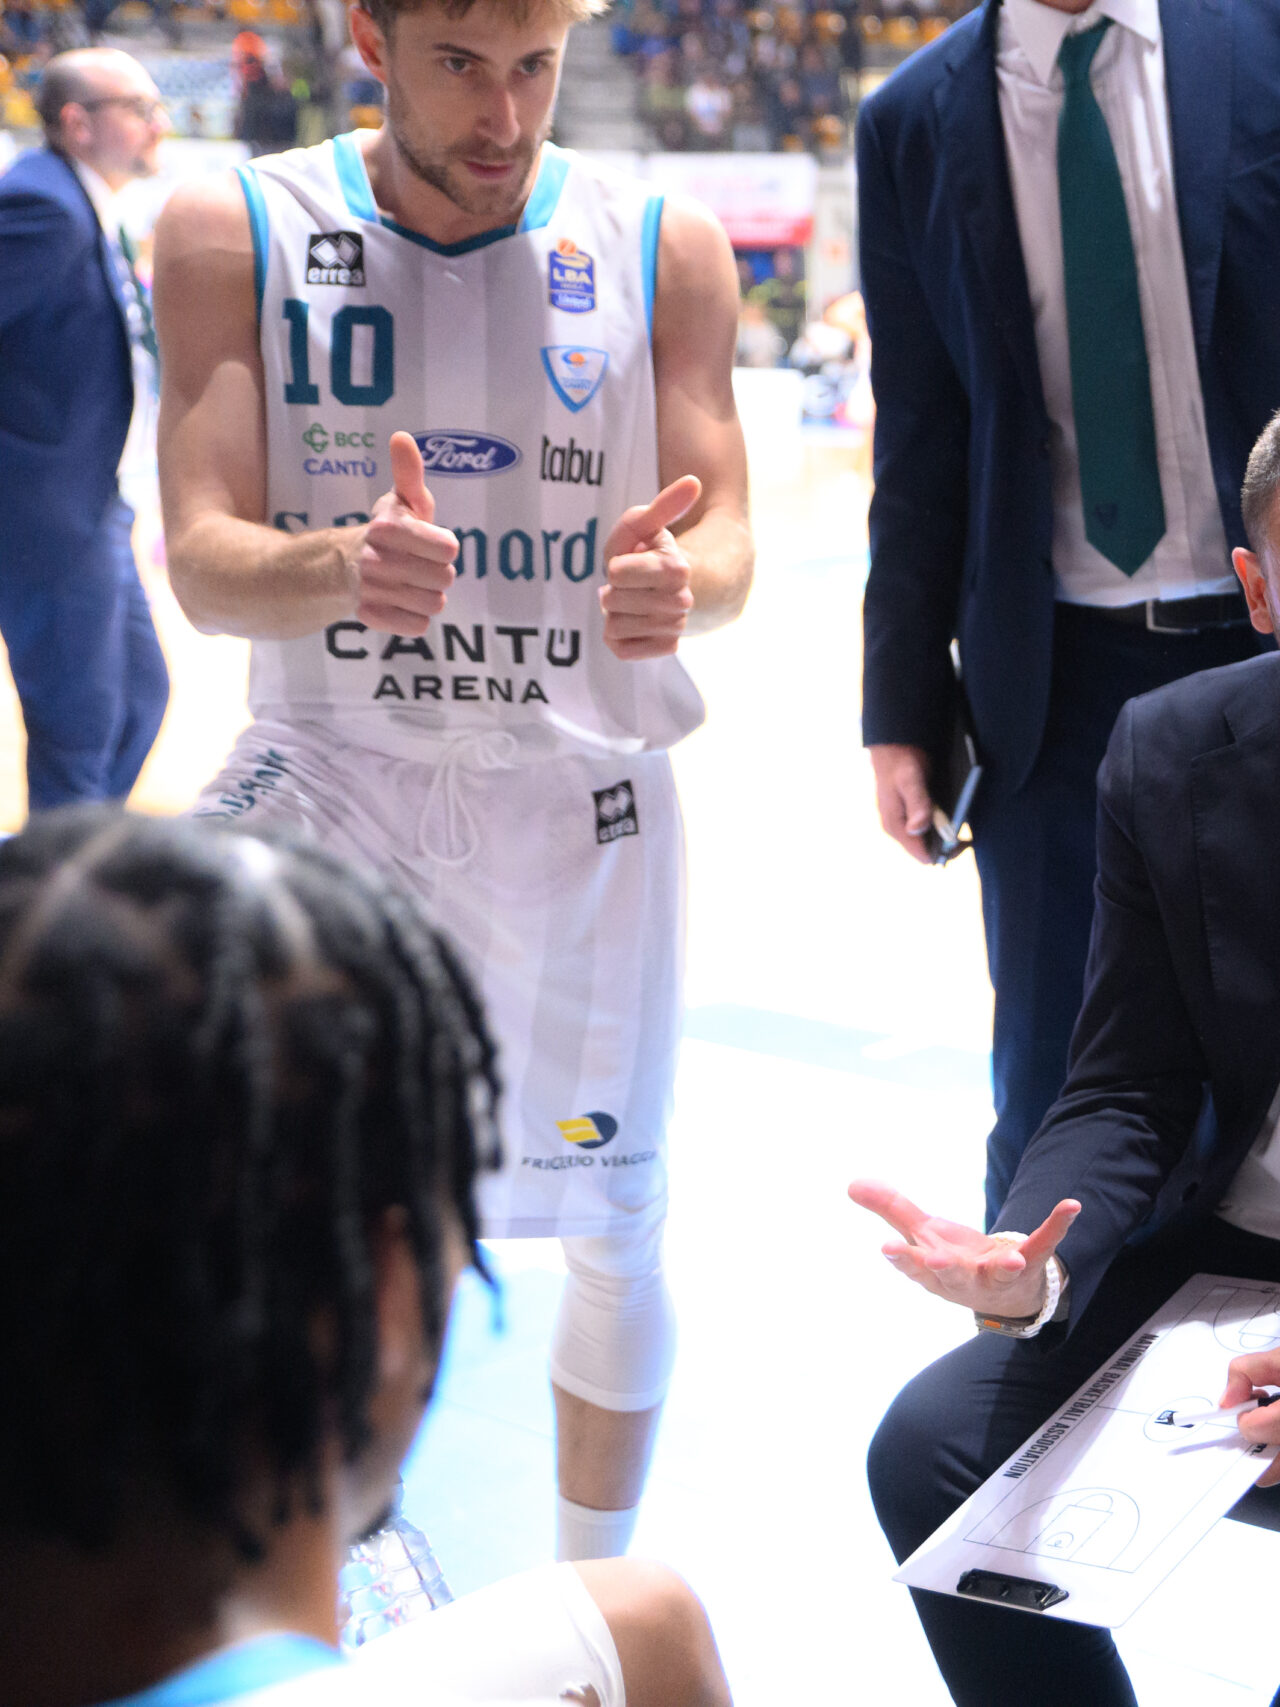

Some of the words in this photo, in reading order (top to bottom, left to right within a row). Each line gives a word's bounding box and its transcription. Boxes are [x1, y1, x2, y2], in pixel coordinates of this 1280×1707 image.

[553, 266, 592, 285] LBA
[282, 298, 394, 406] 10
[335, 431, 375, 448] BCC
[424, 436, 497, 470] Ford
[303, 457, 377, 478] CANTÙ
[540, 434, 604, 486] tabu
[373, 674, 550, 704] ARENA
[1108, 1333, 1159, 1371] NATIONAL
[1059, 1371, 1121, 1422] BASKETBALL
[1002, 1422, 1070, 1479] ASSOCIATION
